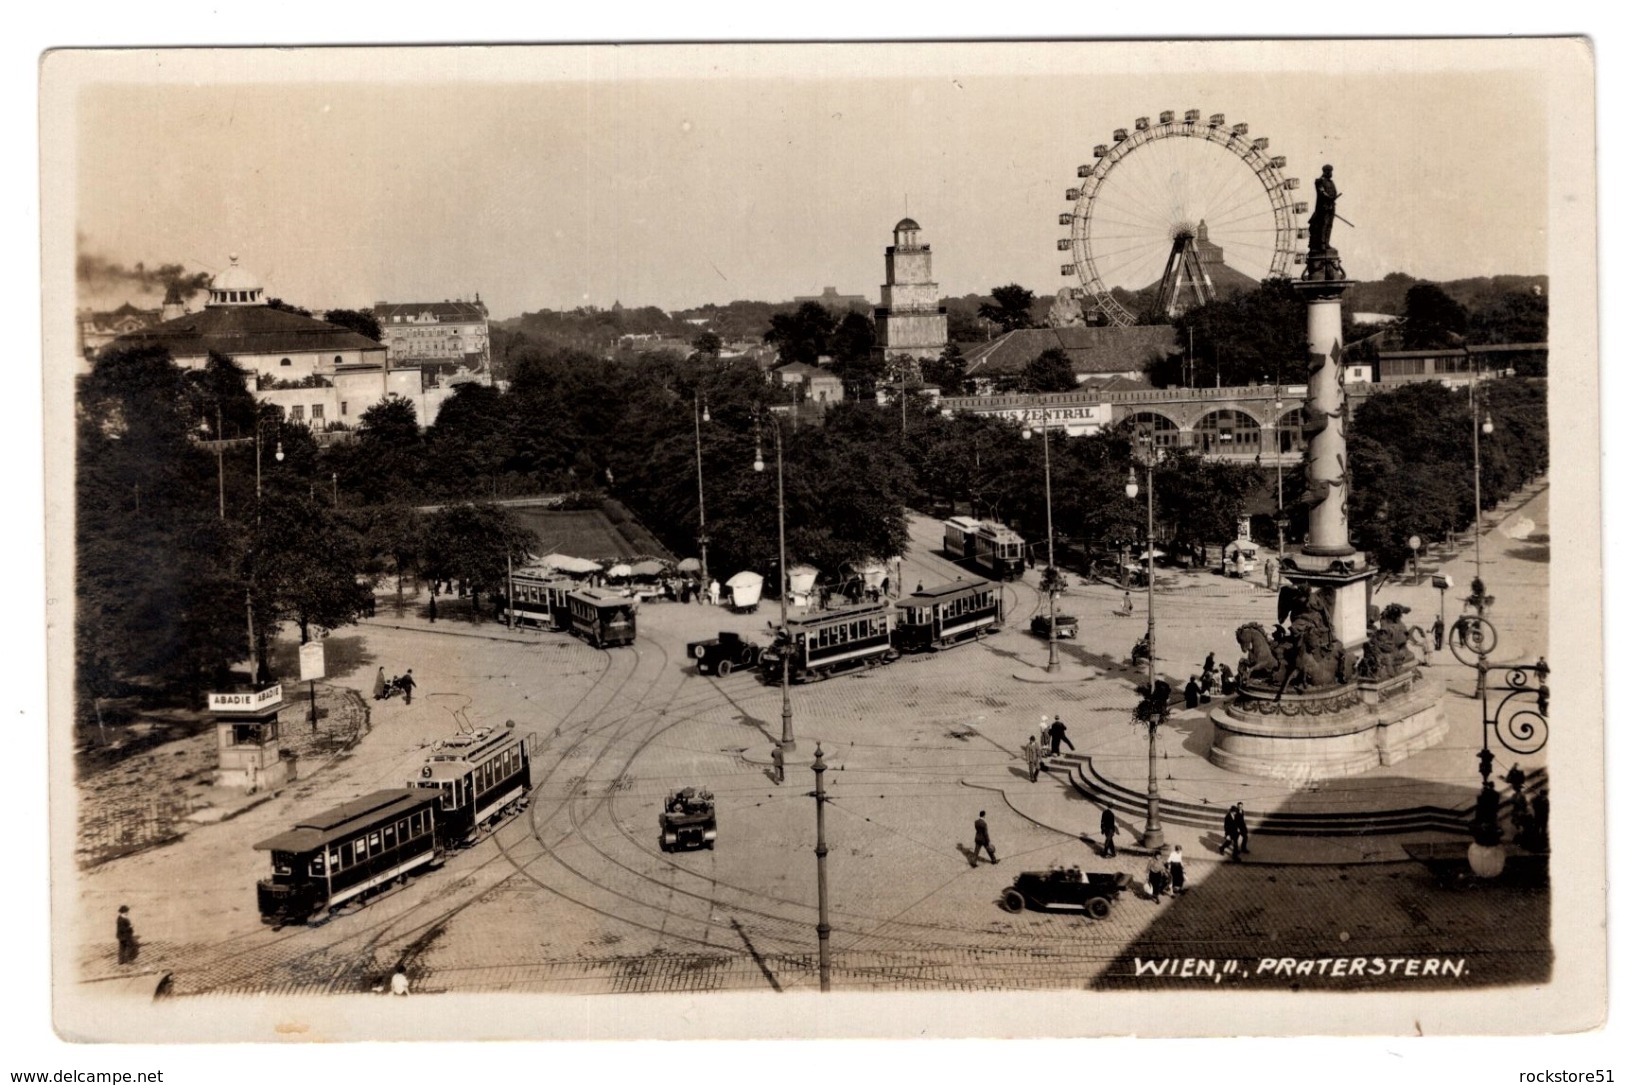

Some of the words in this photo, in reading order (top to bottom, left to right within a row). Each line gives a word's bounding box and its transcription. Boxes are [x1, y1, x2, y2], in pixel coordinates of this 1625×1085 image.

[1021, 408, 1094, 420] ZENTRAL
[214, 696, 251, 704] ABADIE
[424, 766, 430, 777] 5
